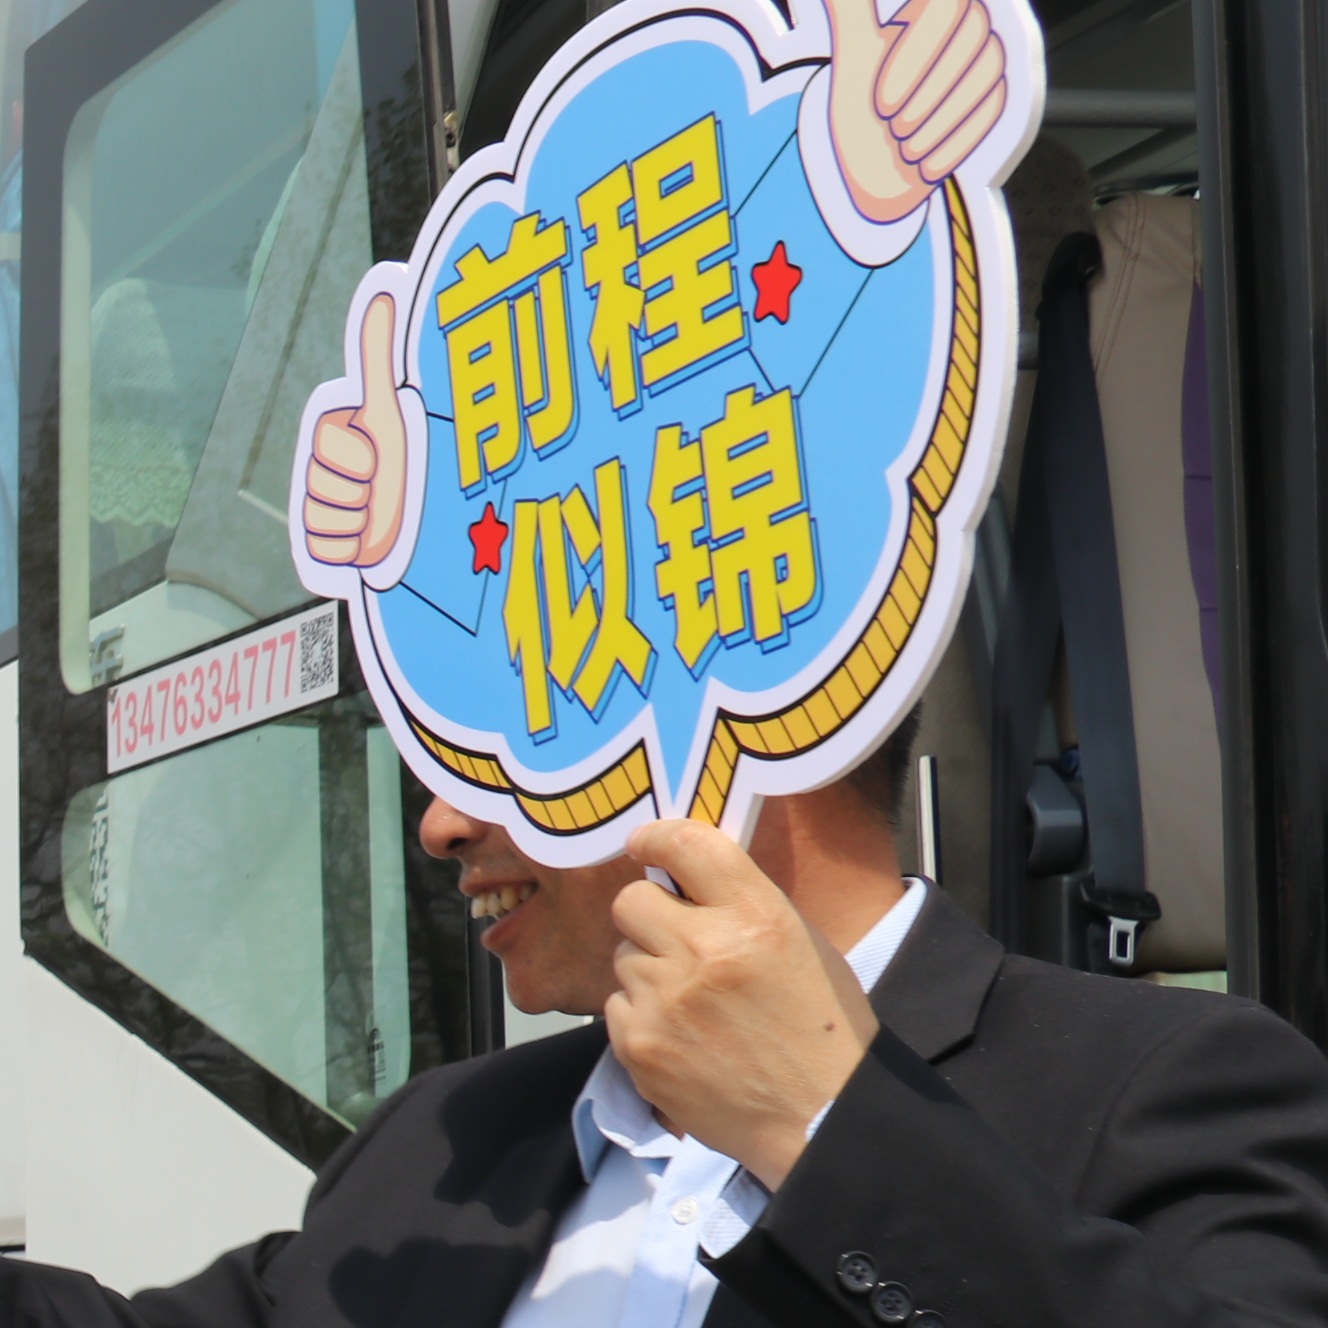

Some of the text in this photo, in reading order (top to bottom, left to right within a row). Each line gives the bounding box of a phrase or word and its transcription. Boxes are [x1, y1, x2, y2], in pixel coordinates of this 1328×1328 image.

[436, 111, 751, 499] 前程
[111, 629, 296, 757] 13476334777
[502, 383, 825, 744] 似锦
